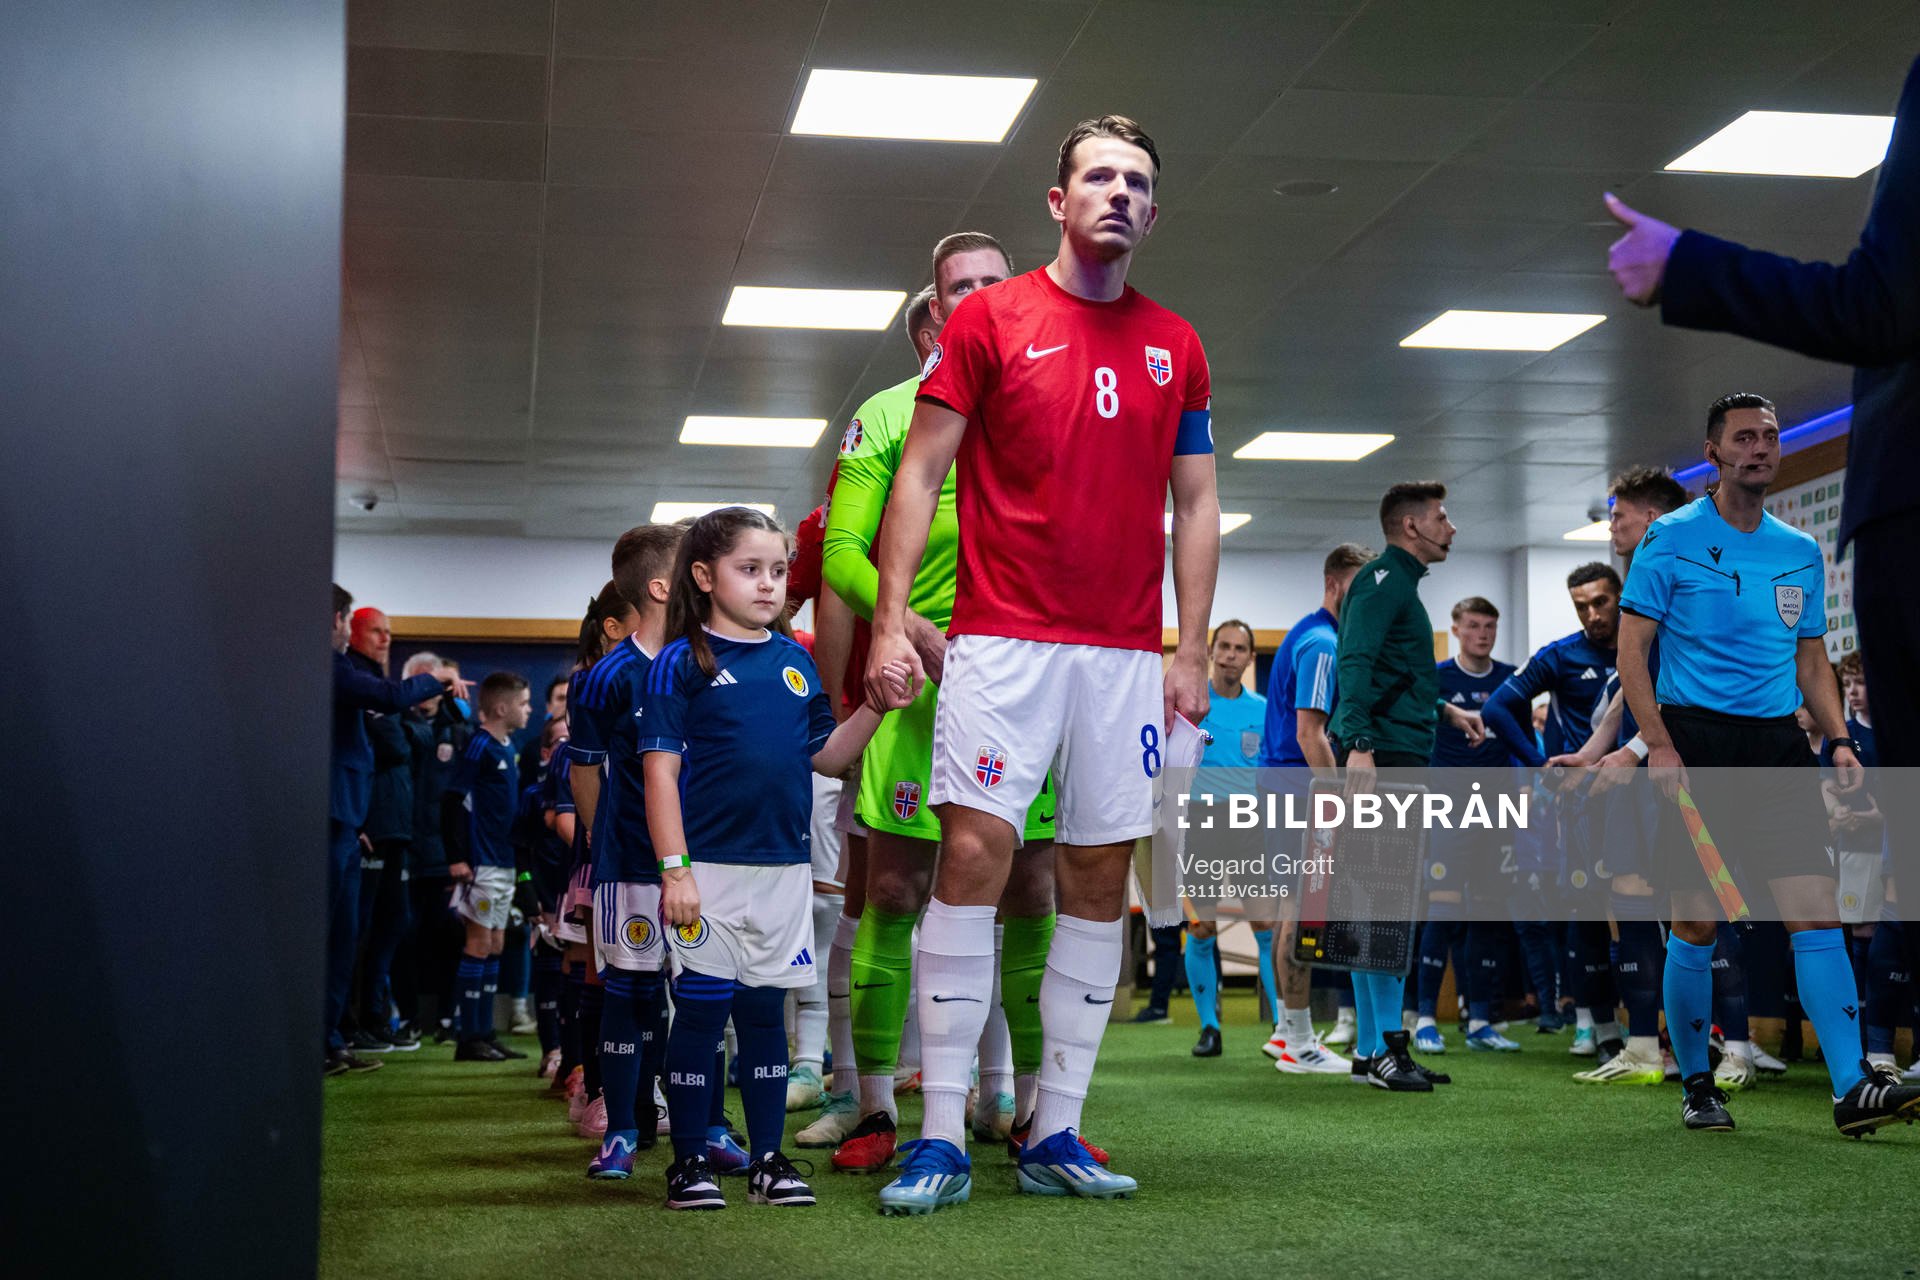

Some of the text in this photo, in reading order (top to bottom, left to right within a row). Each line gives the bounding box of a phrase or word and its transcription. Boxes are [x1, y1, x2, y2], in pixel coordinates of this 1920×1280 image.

[1095, 366, 1119, 419] 8
[1140, 723, 1162, 779] 8
[603, 1041, 635, 1055] ALBA
[670, 1072, 706, 1087] ALBA
[754, 1064, 788, 1080] ALBA
